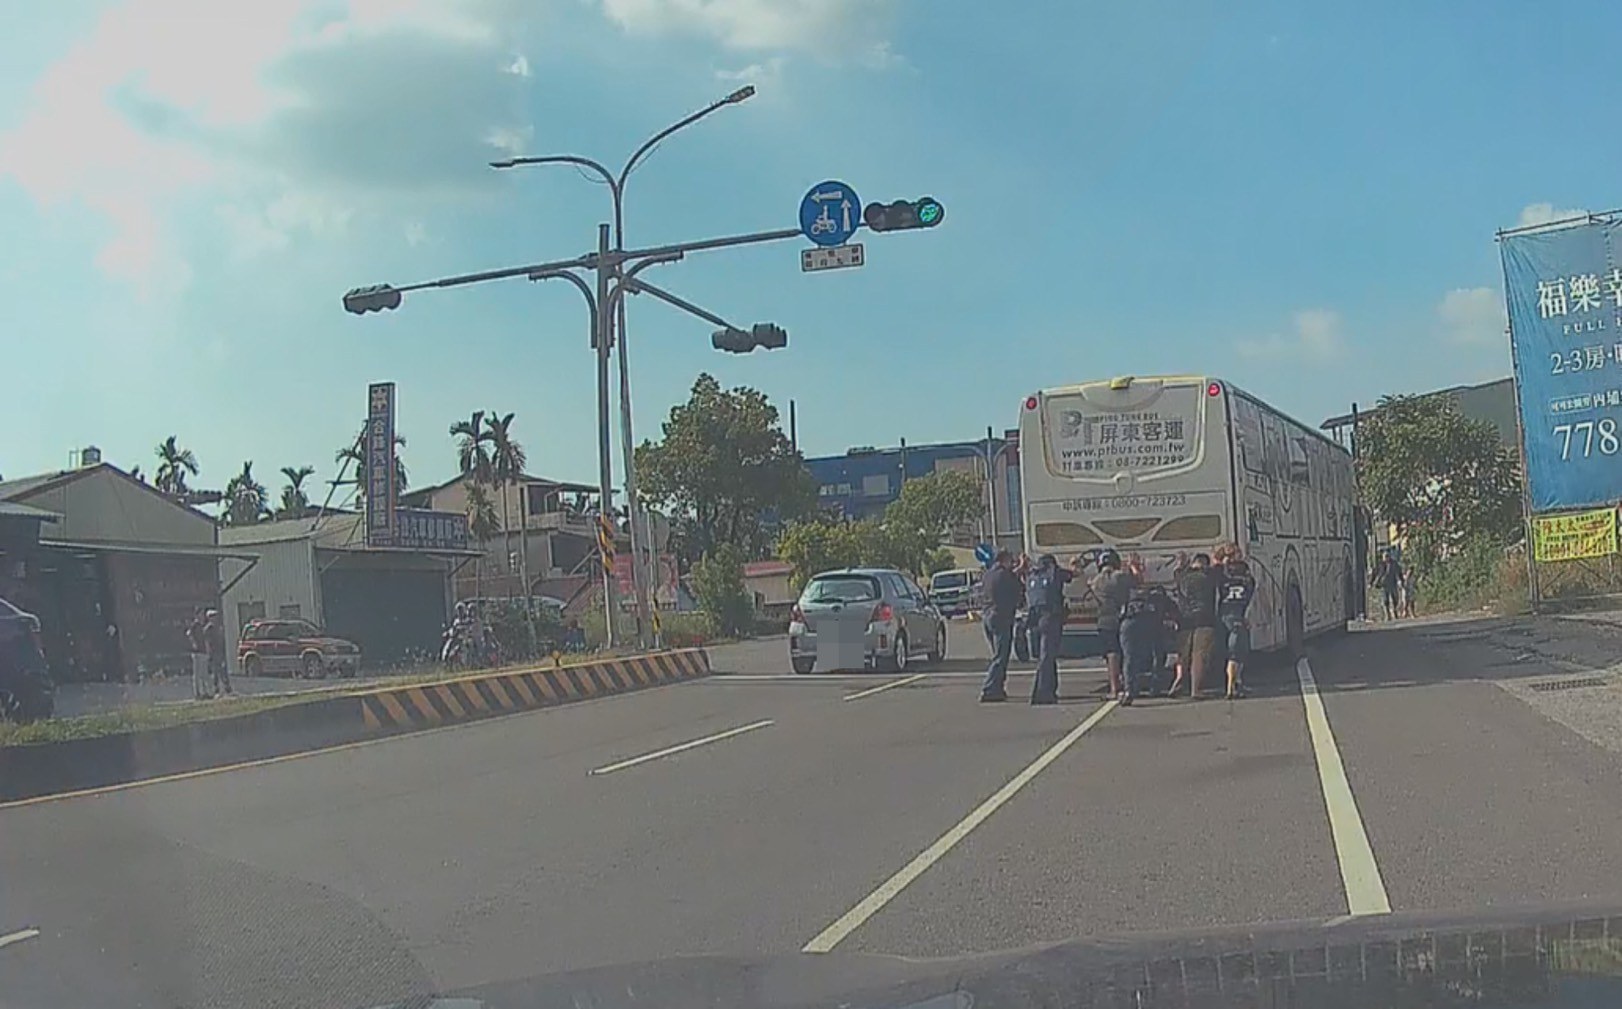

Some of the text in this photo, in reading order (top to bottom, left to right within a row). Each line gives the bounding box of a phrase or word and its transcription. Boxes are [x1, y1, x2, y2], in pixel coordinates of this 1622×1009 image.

[1563, 320, 1606, 335] FULL
[1100, 421, 1184, 444] 屏東客運
[1552, 419, 1619, 461] 778
[1062, 443, 1185, 458] www.ptbus.com.tw
